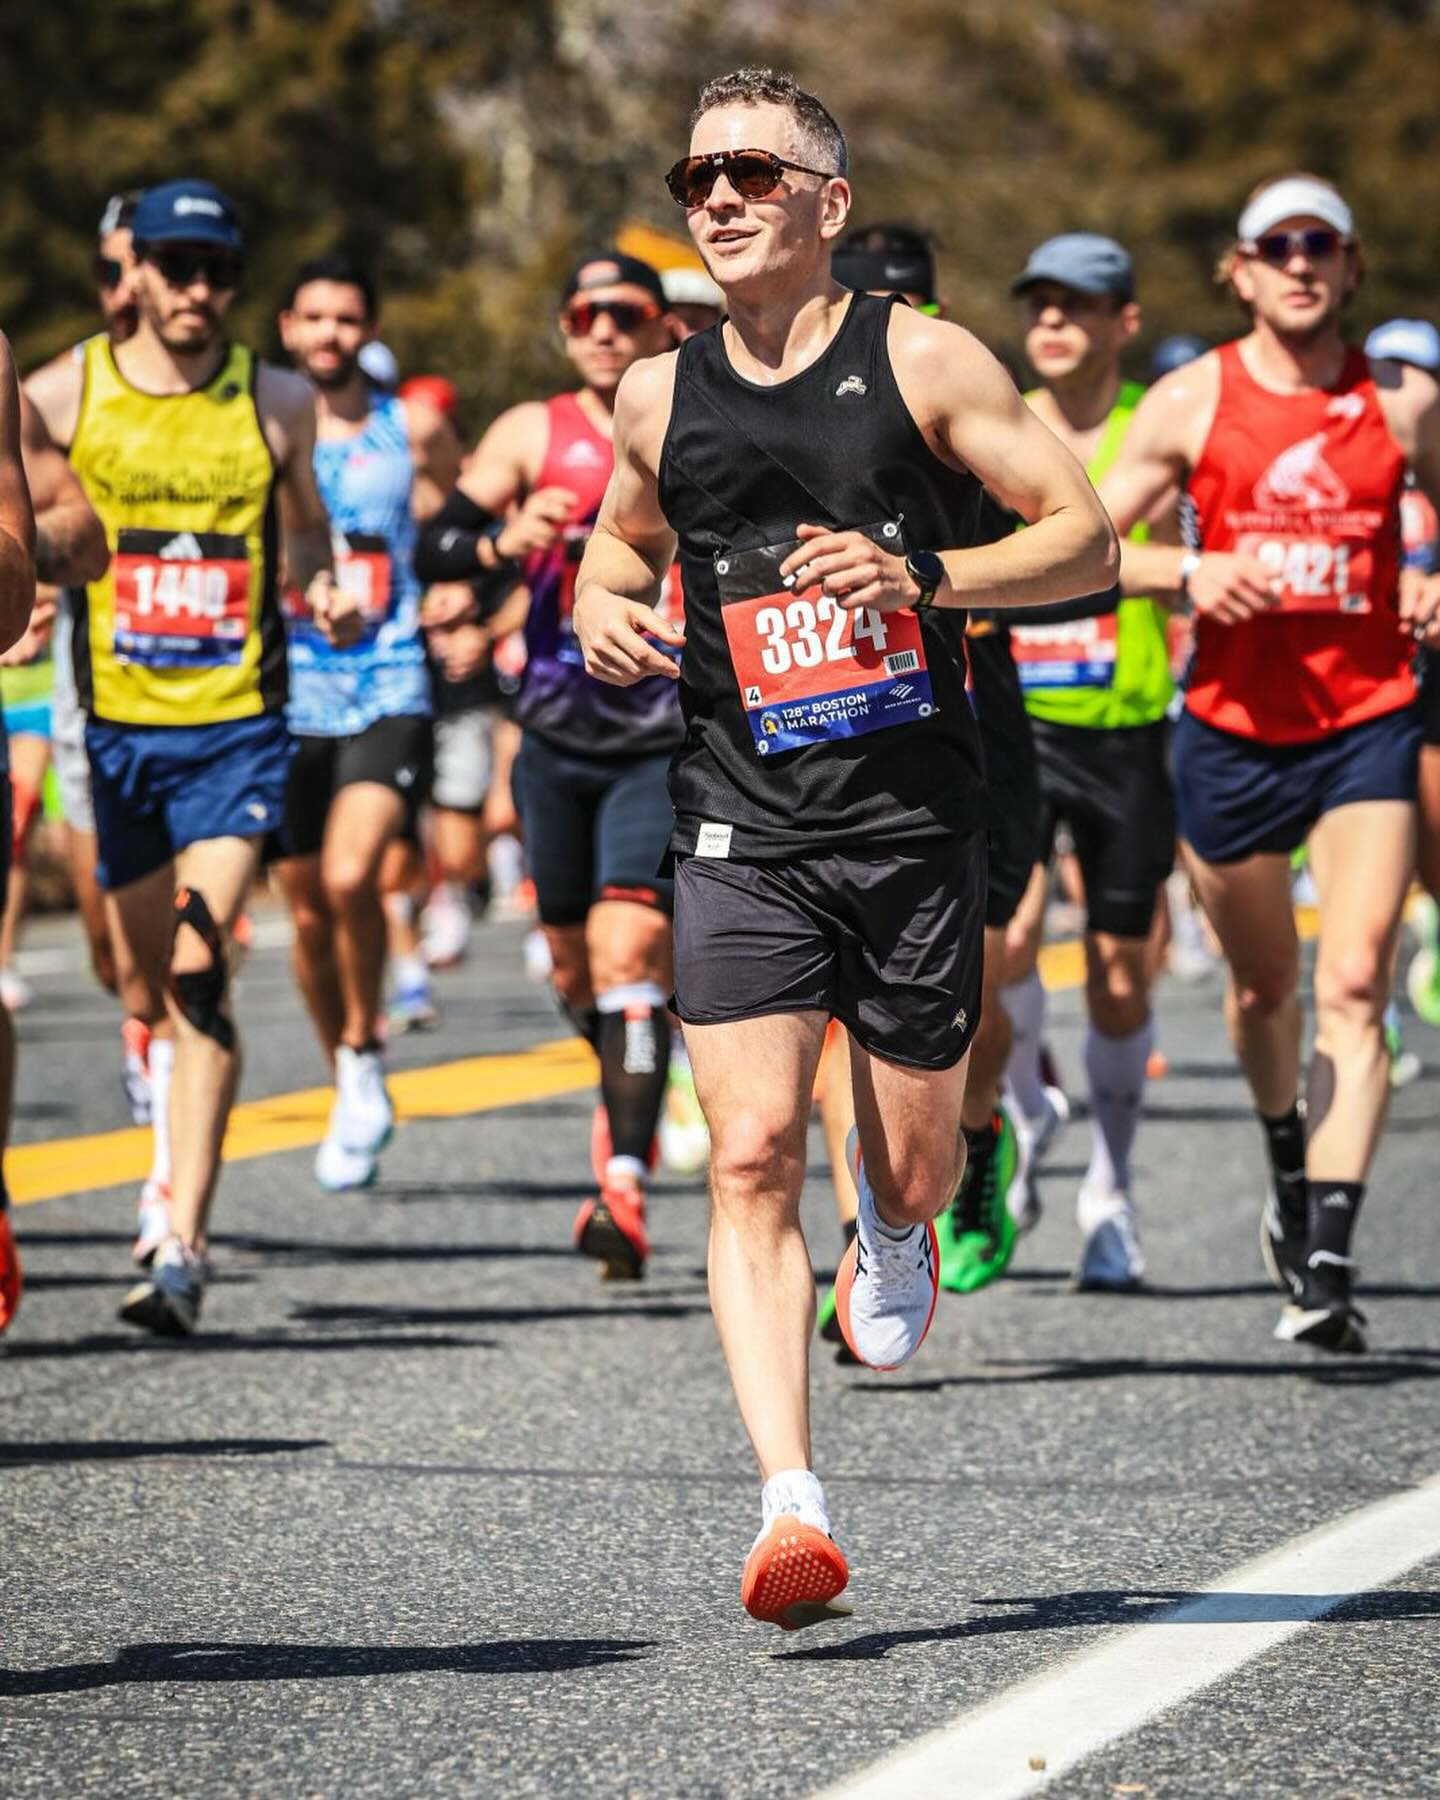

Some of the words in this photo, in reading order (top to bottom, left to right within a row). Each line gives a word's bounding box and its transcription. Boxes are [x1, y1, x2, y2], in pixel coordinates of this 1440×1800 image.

[133, 564, 229, 618] 1440
[755, 597, 888, 674] 3324
[749, 688, 760, 702] 4
[812, 692, 867, 714] BOSTON
[786, 704, 870, 731] MARATHON
